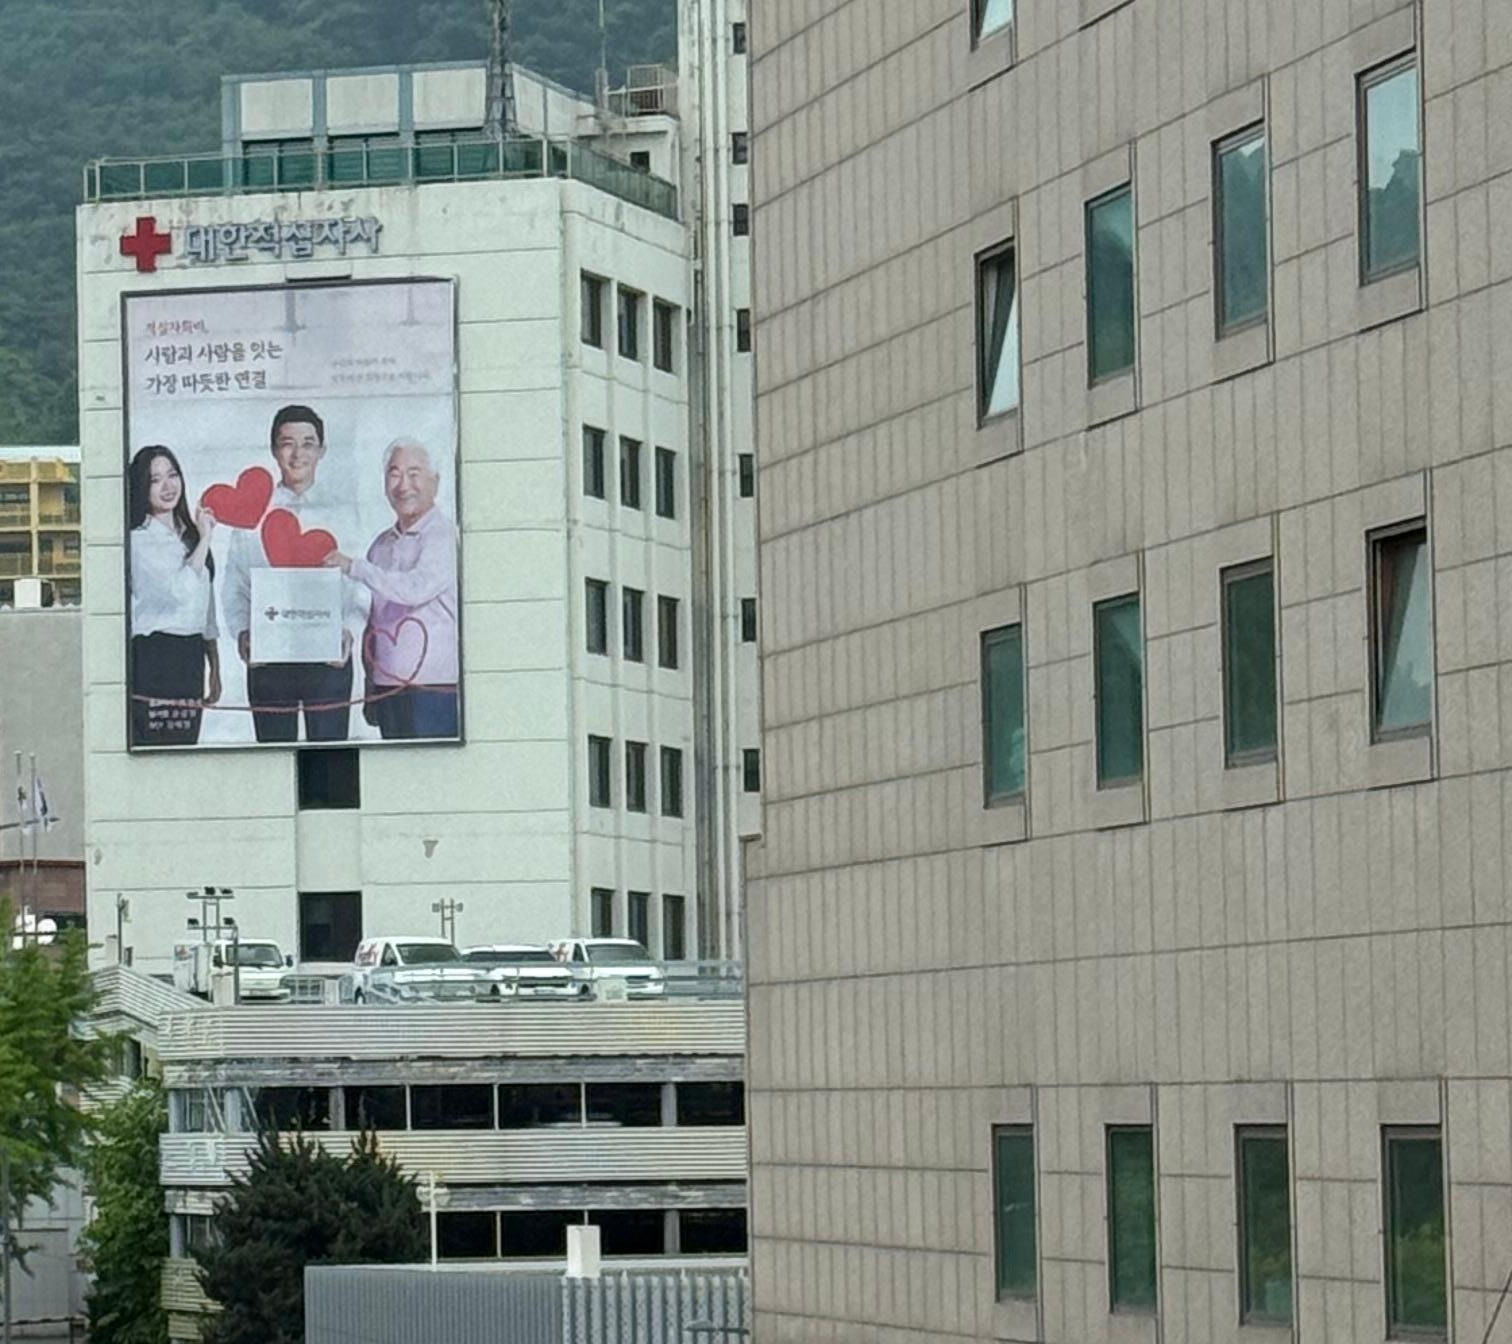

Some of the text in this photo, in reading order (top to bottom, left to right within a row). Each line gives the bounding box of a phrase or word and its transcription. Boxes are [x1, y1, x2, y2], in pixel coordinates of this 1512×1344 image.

[183, 217, 383, 263] 대한적십자사
[145, 340, 283, 365] 사람과 사람을 잇는
[145, 369, 266, 394] 가장 따뜻한 연결
